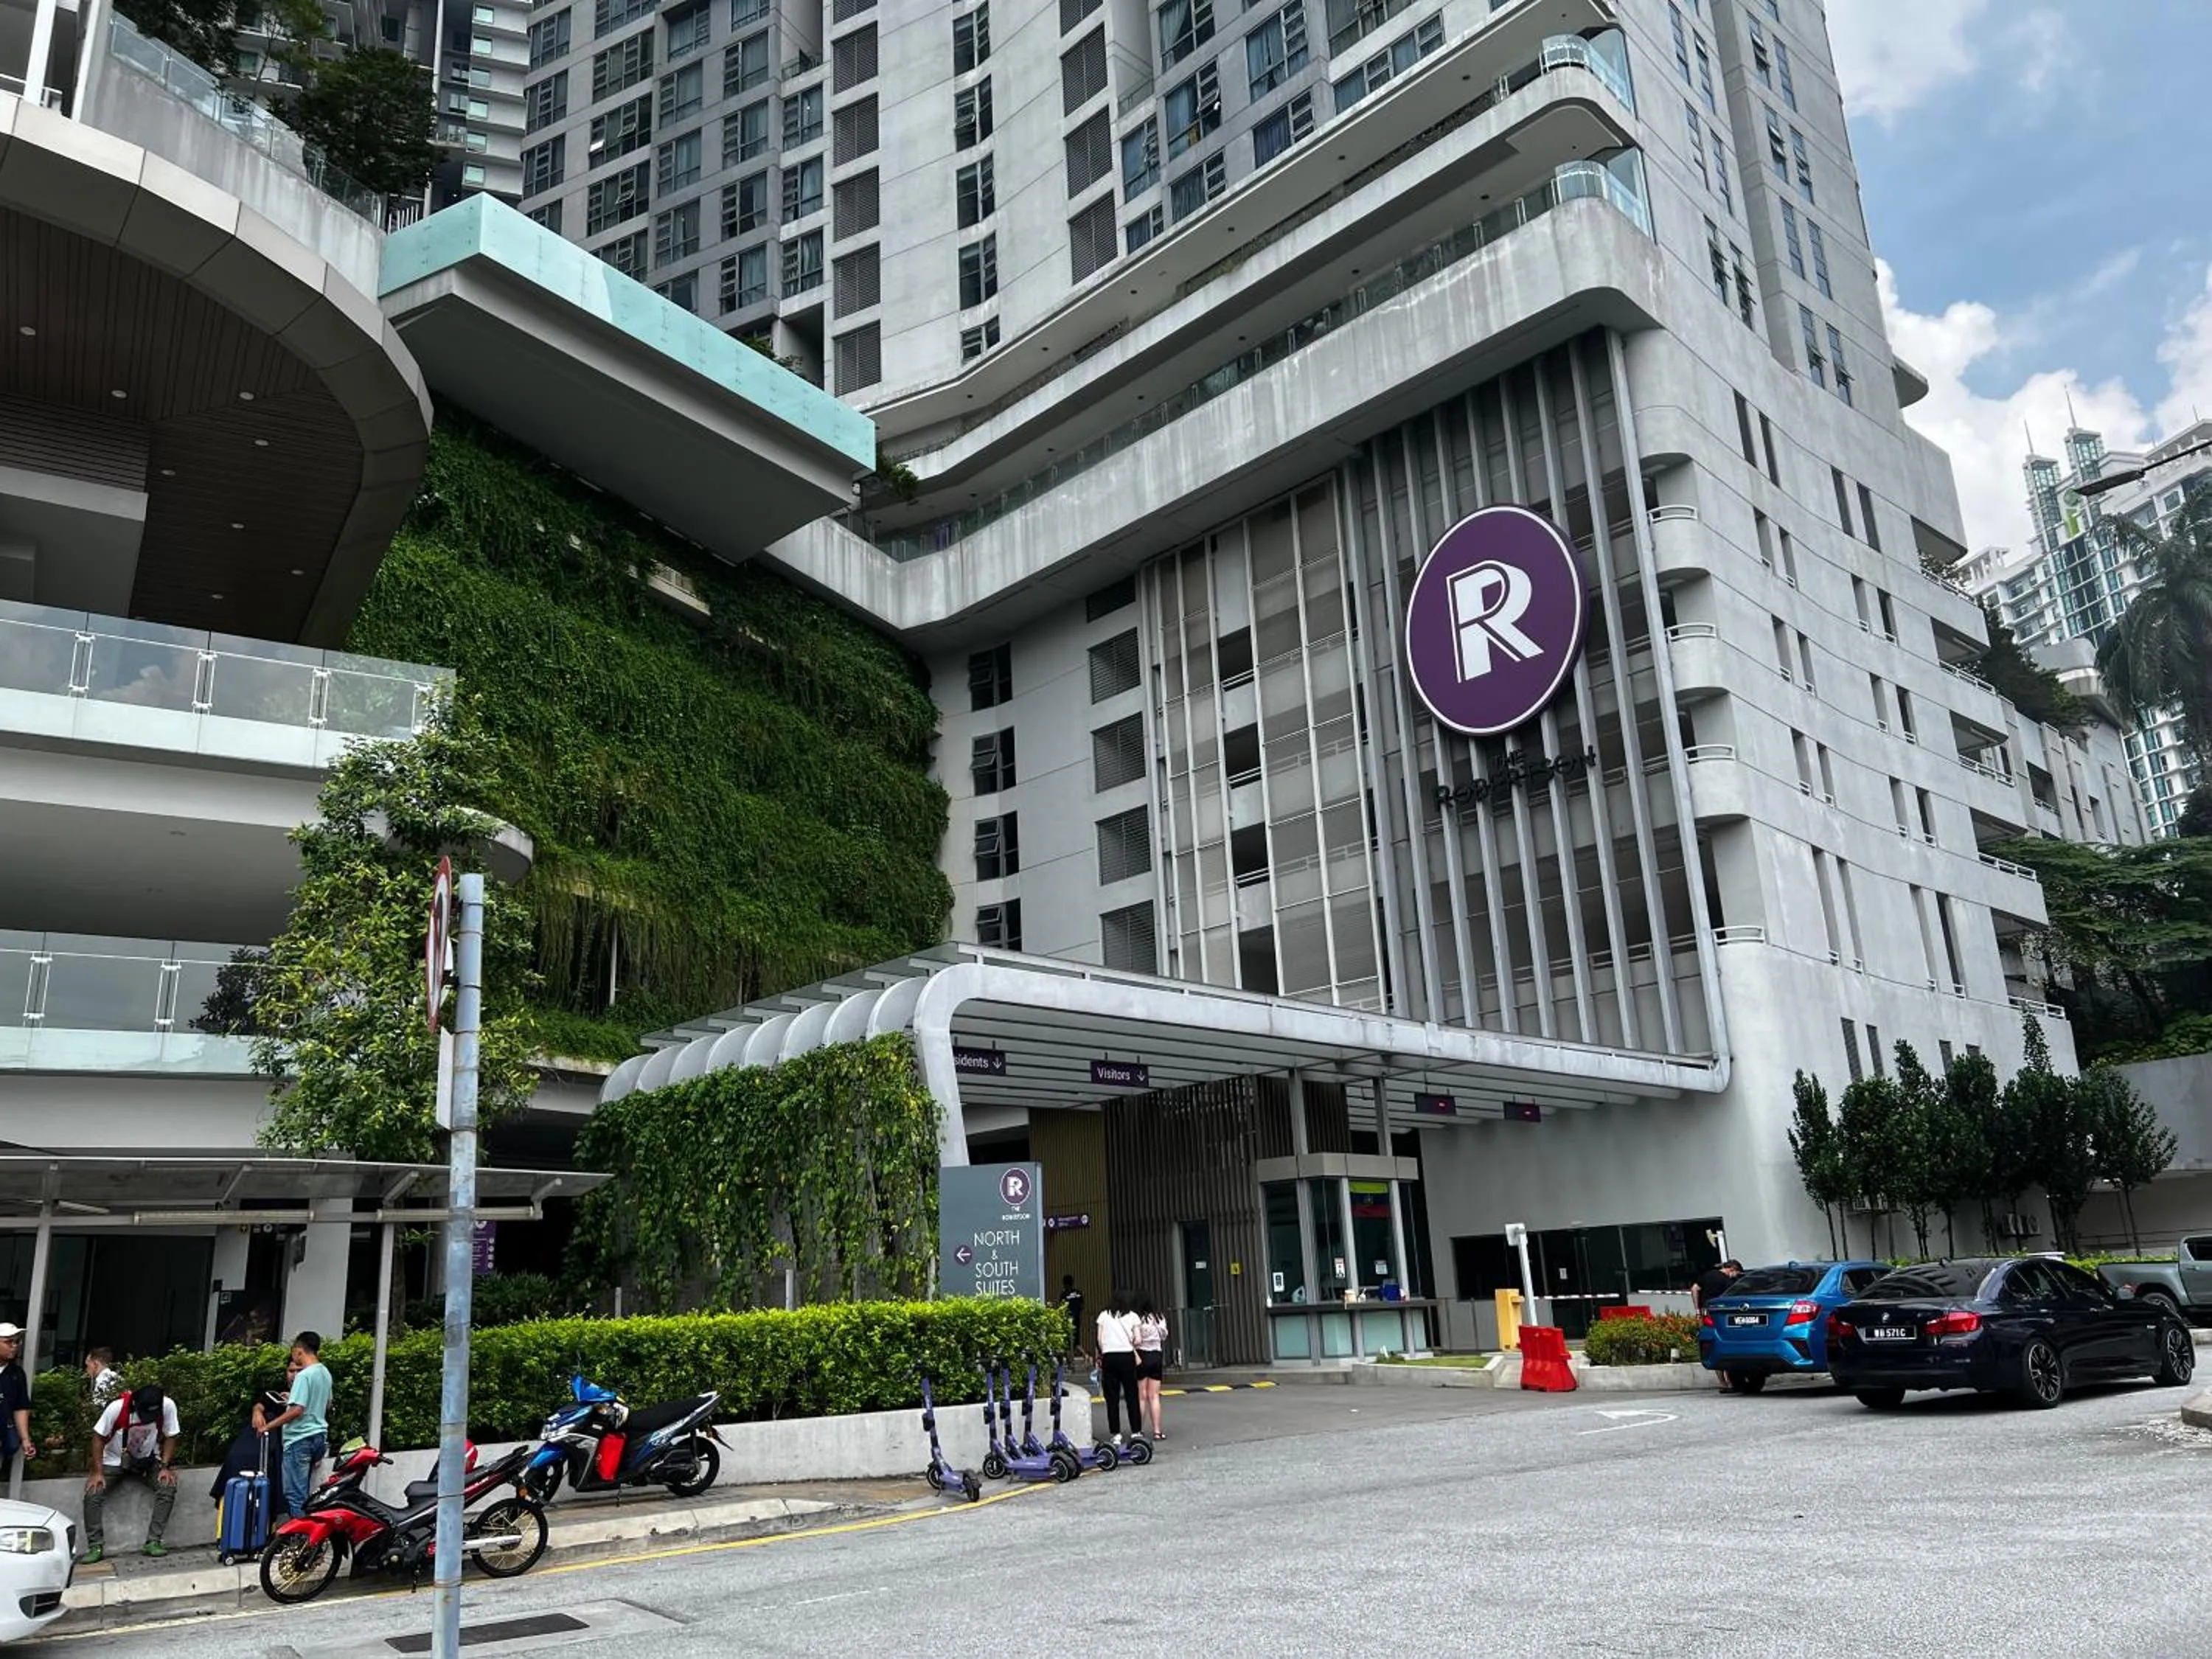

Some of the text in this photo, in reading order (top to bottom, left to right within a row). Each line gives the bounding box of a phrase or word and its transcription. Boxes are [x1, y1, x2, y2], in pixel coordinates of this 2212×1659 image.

[1446, 560, 1544, 684] R
[954, 1054, 989, 1068] sidents
[1097, 1066, 1130, 1080] Visitors
[1006, 1176, 1023, 1197] R
[974, 1231, 1020, 1247] NORTH
[991, 1249, 998, 1260] &
[975, 1261, 1018, 1278] SOUTH
[975, 1279, 1015, 1296] SUITES
